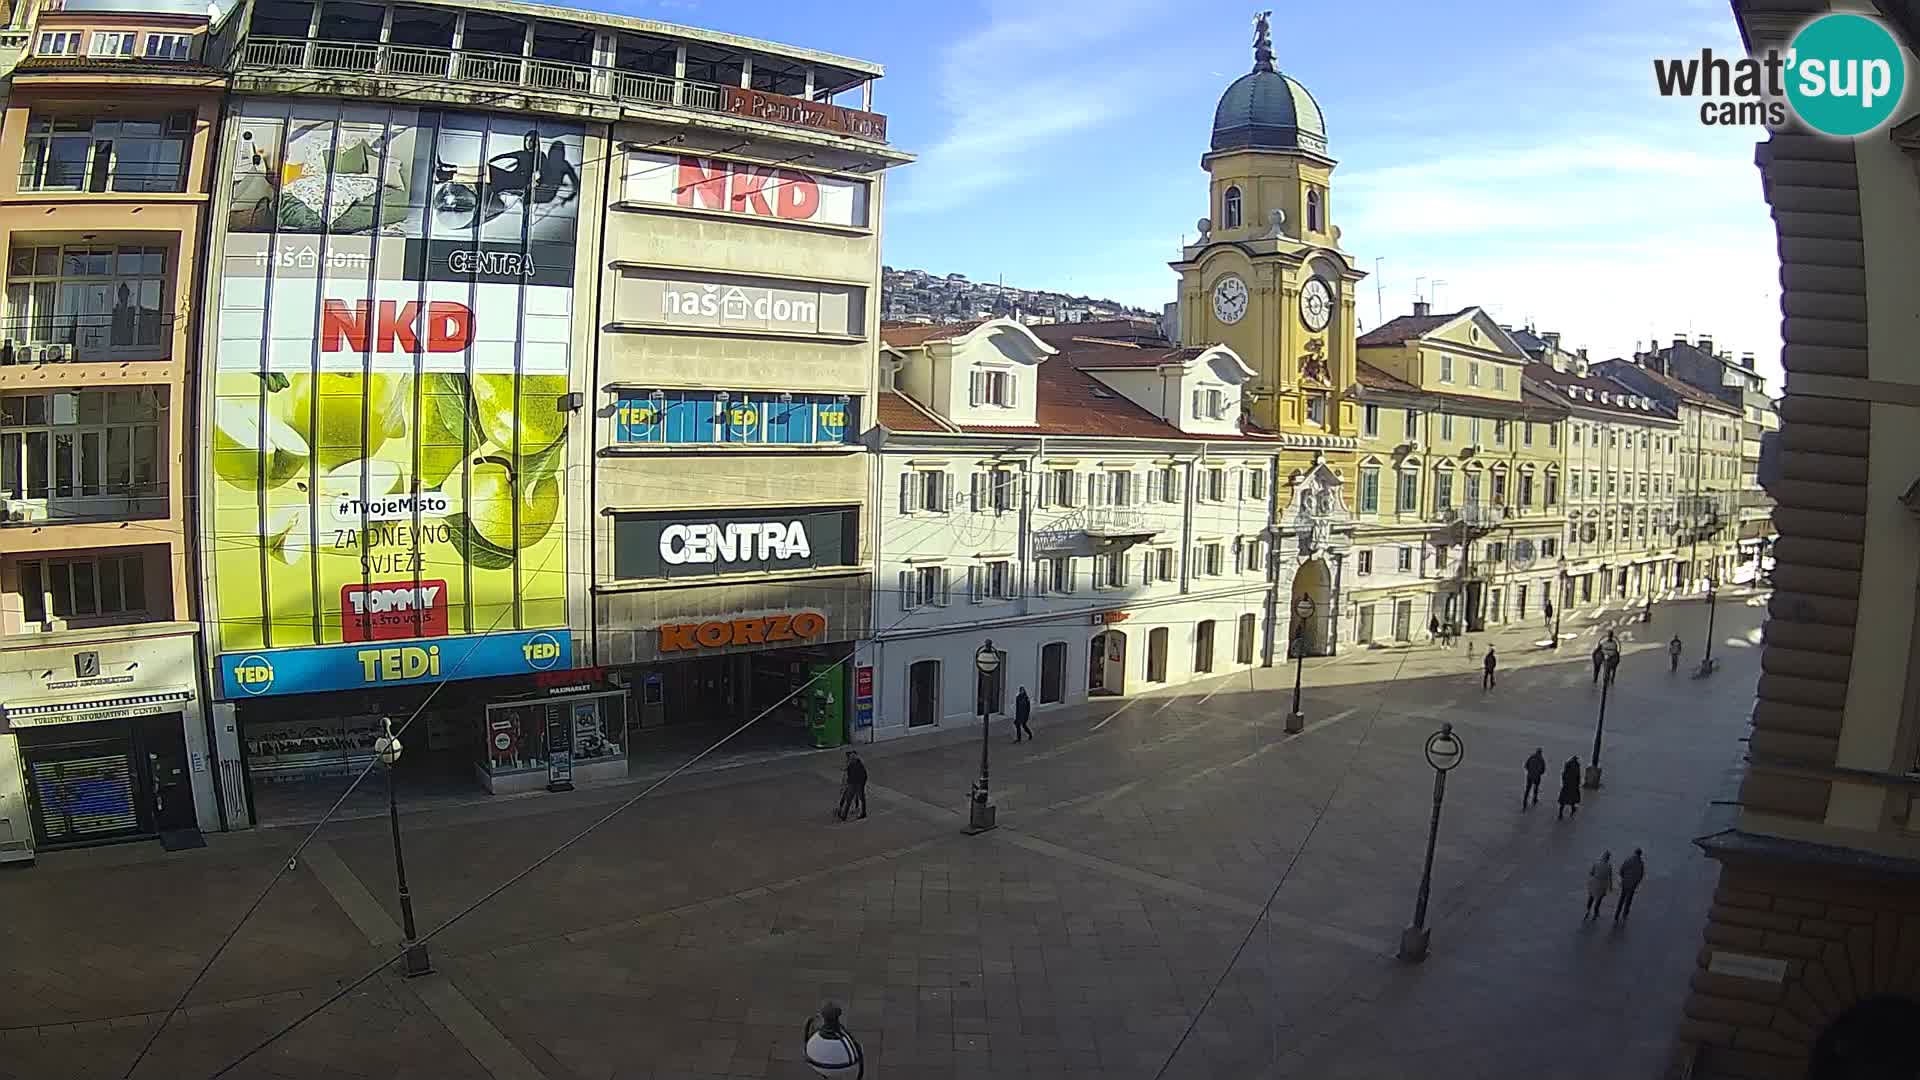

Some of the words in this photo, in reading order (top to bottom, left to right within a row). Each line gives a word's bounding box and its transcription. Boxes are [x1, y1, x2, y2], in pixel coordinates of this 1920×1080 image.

[676, 155, 820, 220] NKD
[448, 250, 535, 276] CENTRA
[662, 285, 720, 316] naš
[754, 289, 817, 323] dom
[321, 299, 476, 354] NKD
[339, 497, 446, 516] #TvojeMisto
[334, 528, 358, 549] ZA
[367, 524, 451, 548] DNEVNO
[659, 520, 811, 564] CENTRA
[348, 586, 440, 614] TOMMY
[660, 612, 826, 652] KORZO
[358, 645, 441, 682] TEDi
[522, 641, 560, 660] TEDi
[234, 665, 274, 684] TEDi
